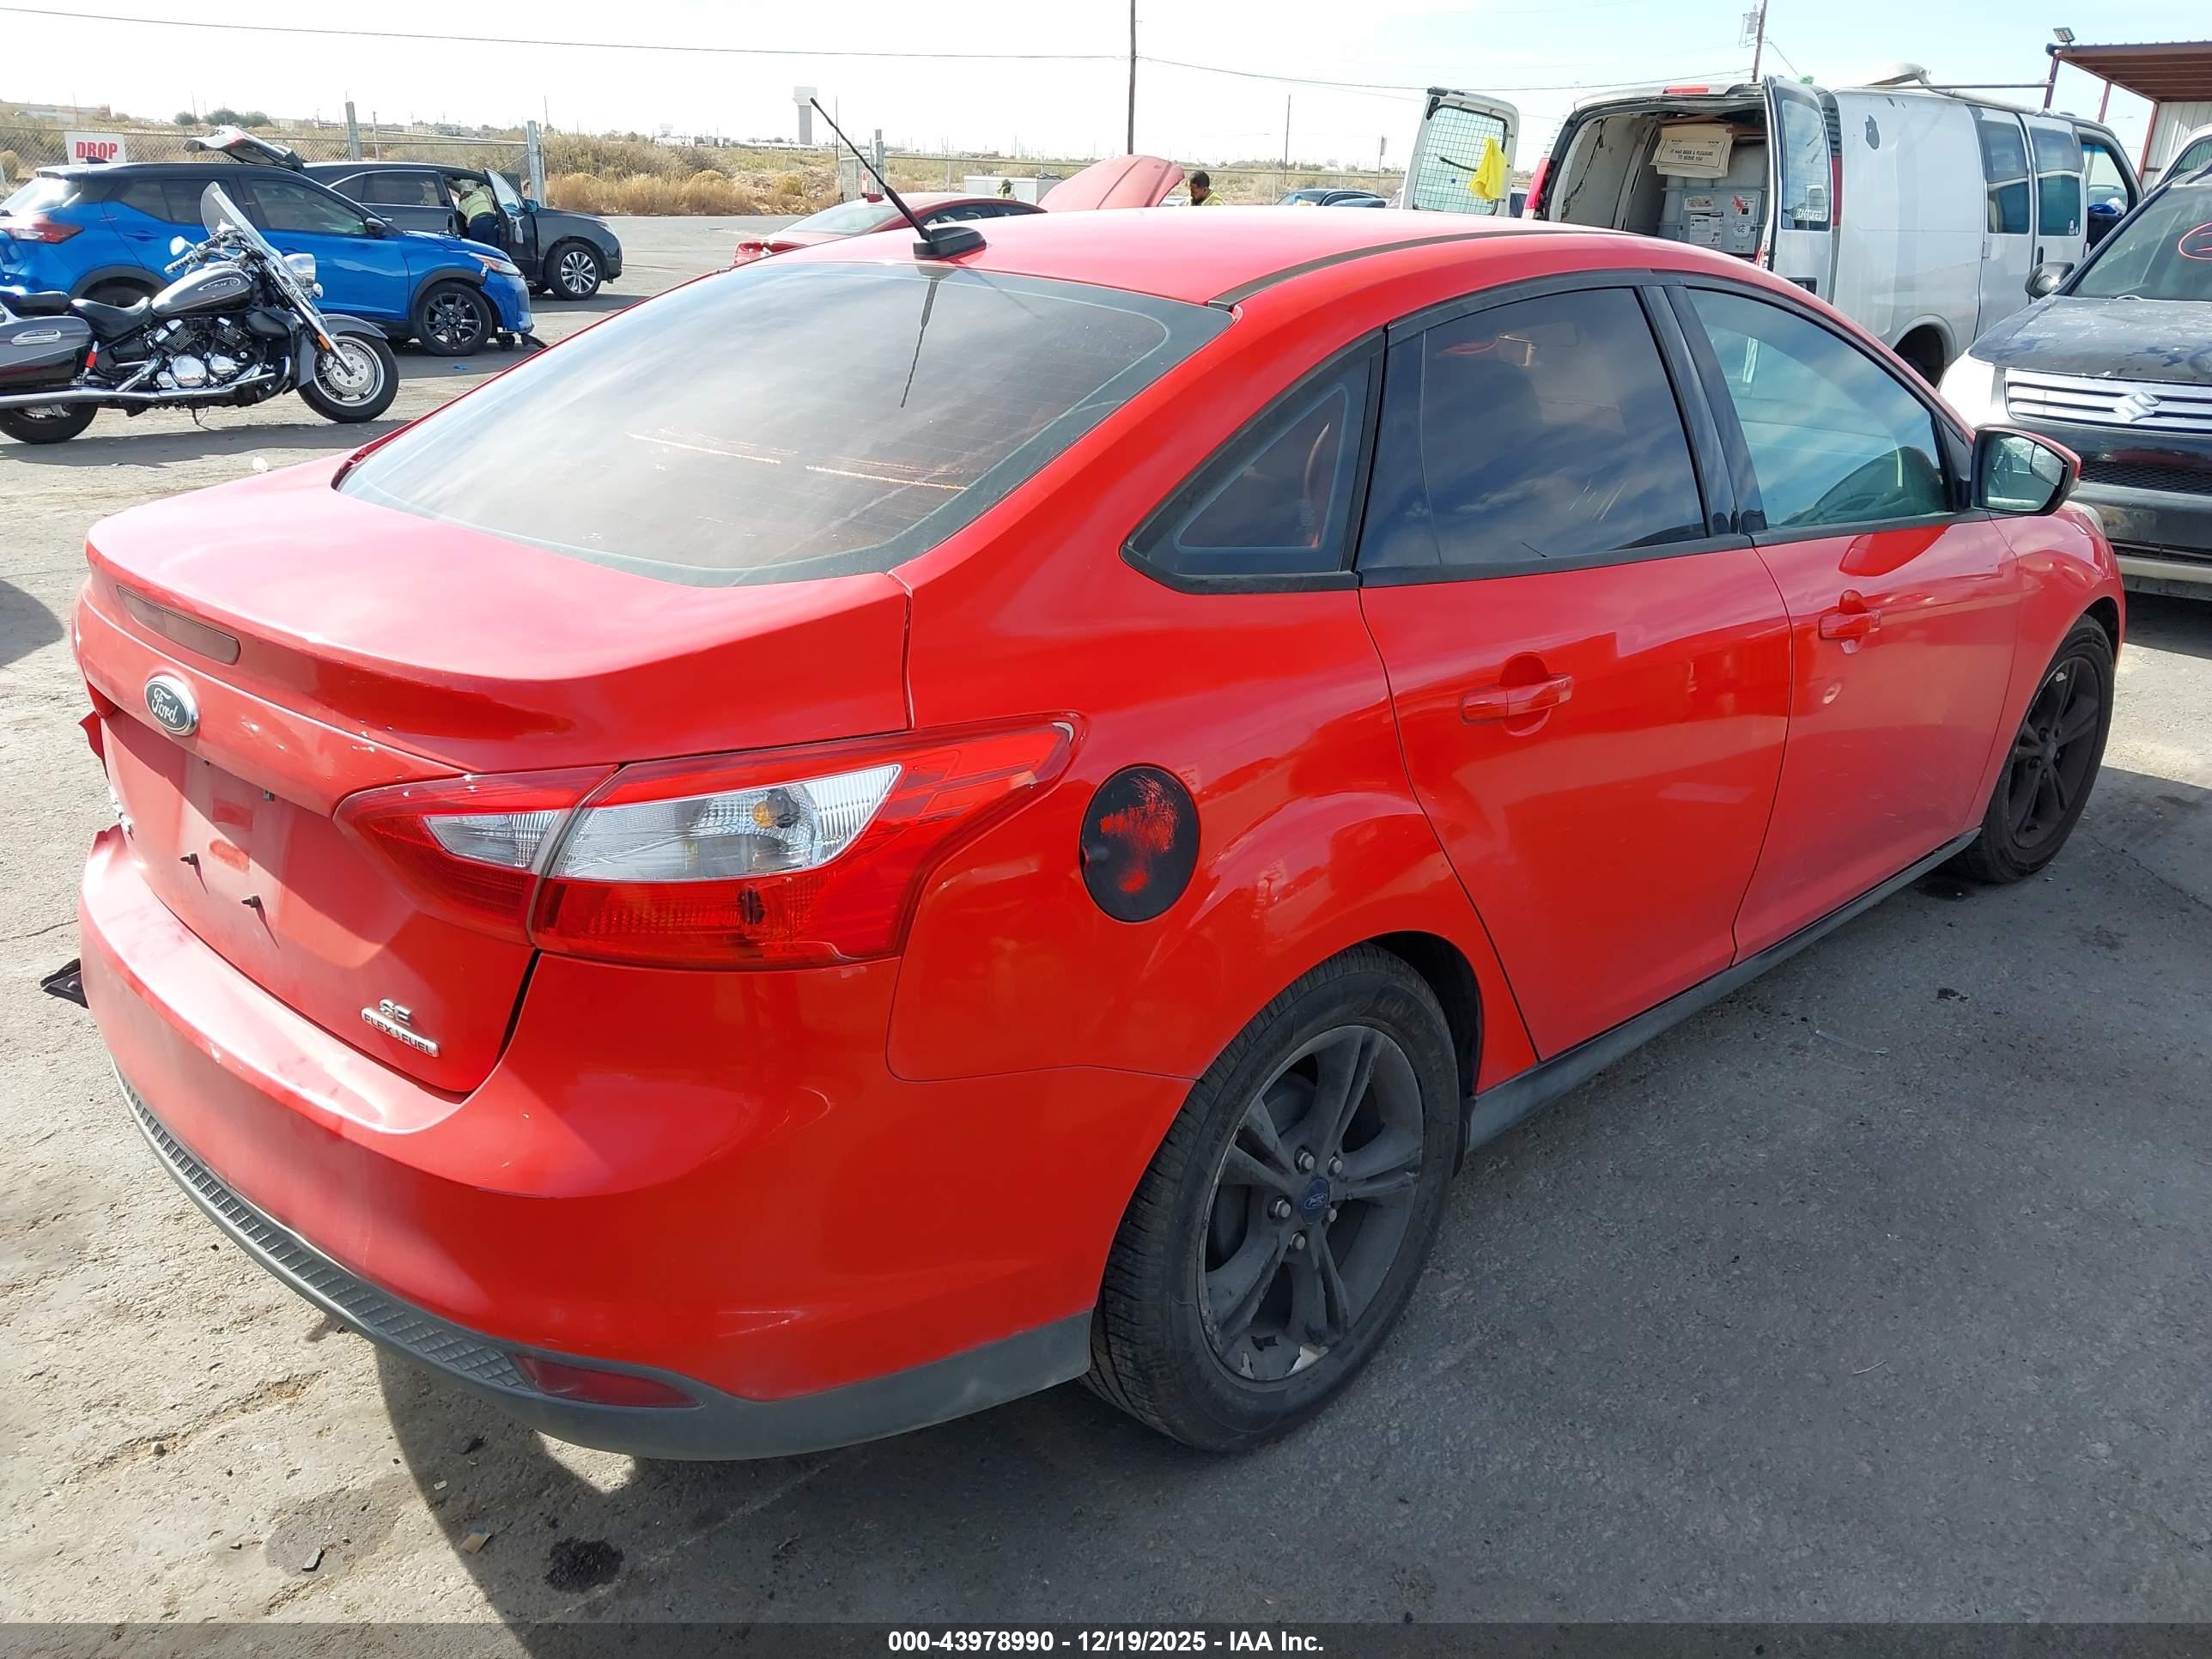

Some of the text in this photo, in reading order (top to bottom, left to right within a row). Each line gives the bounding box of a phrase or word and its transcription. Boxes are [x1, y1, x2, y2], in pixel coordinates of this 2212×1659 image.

[76, 141, 118, 160] DROP
[151, 687, 179, 724] Ford
[379, 999, 412, 1026] SE
[364, 1013, 434, 1056] FLEX FUEL
